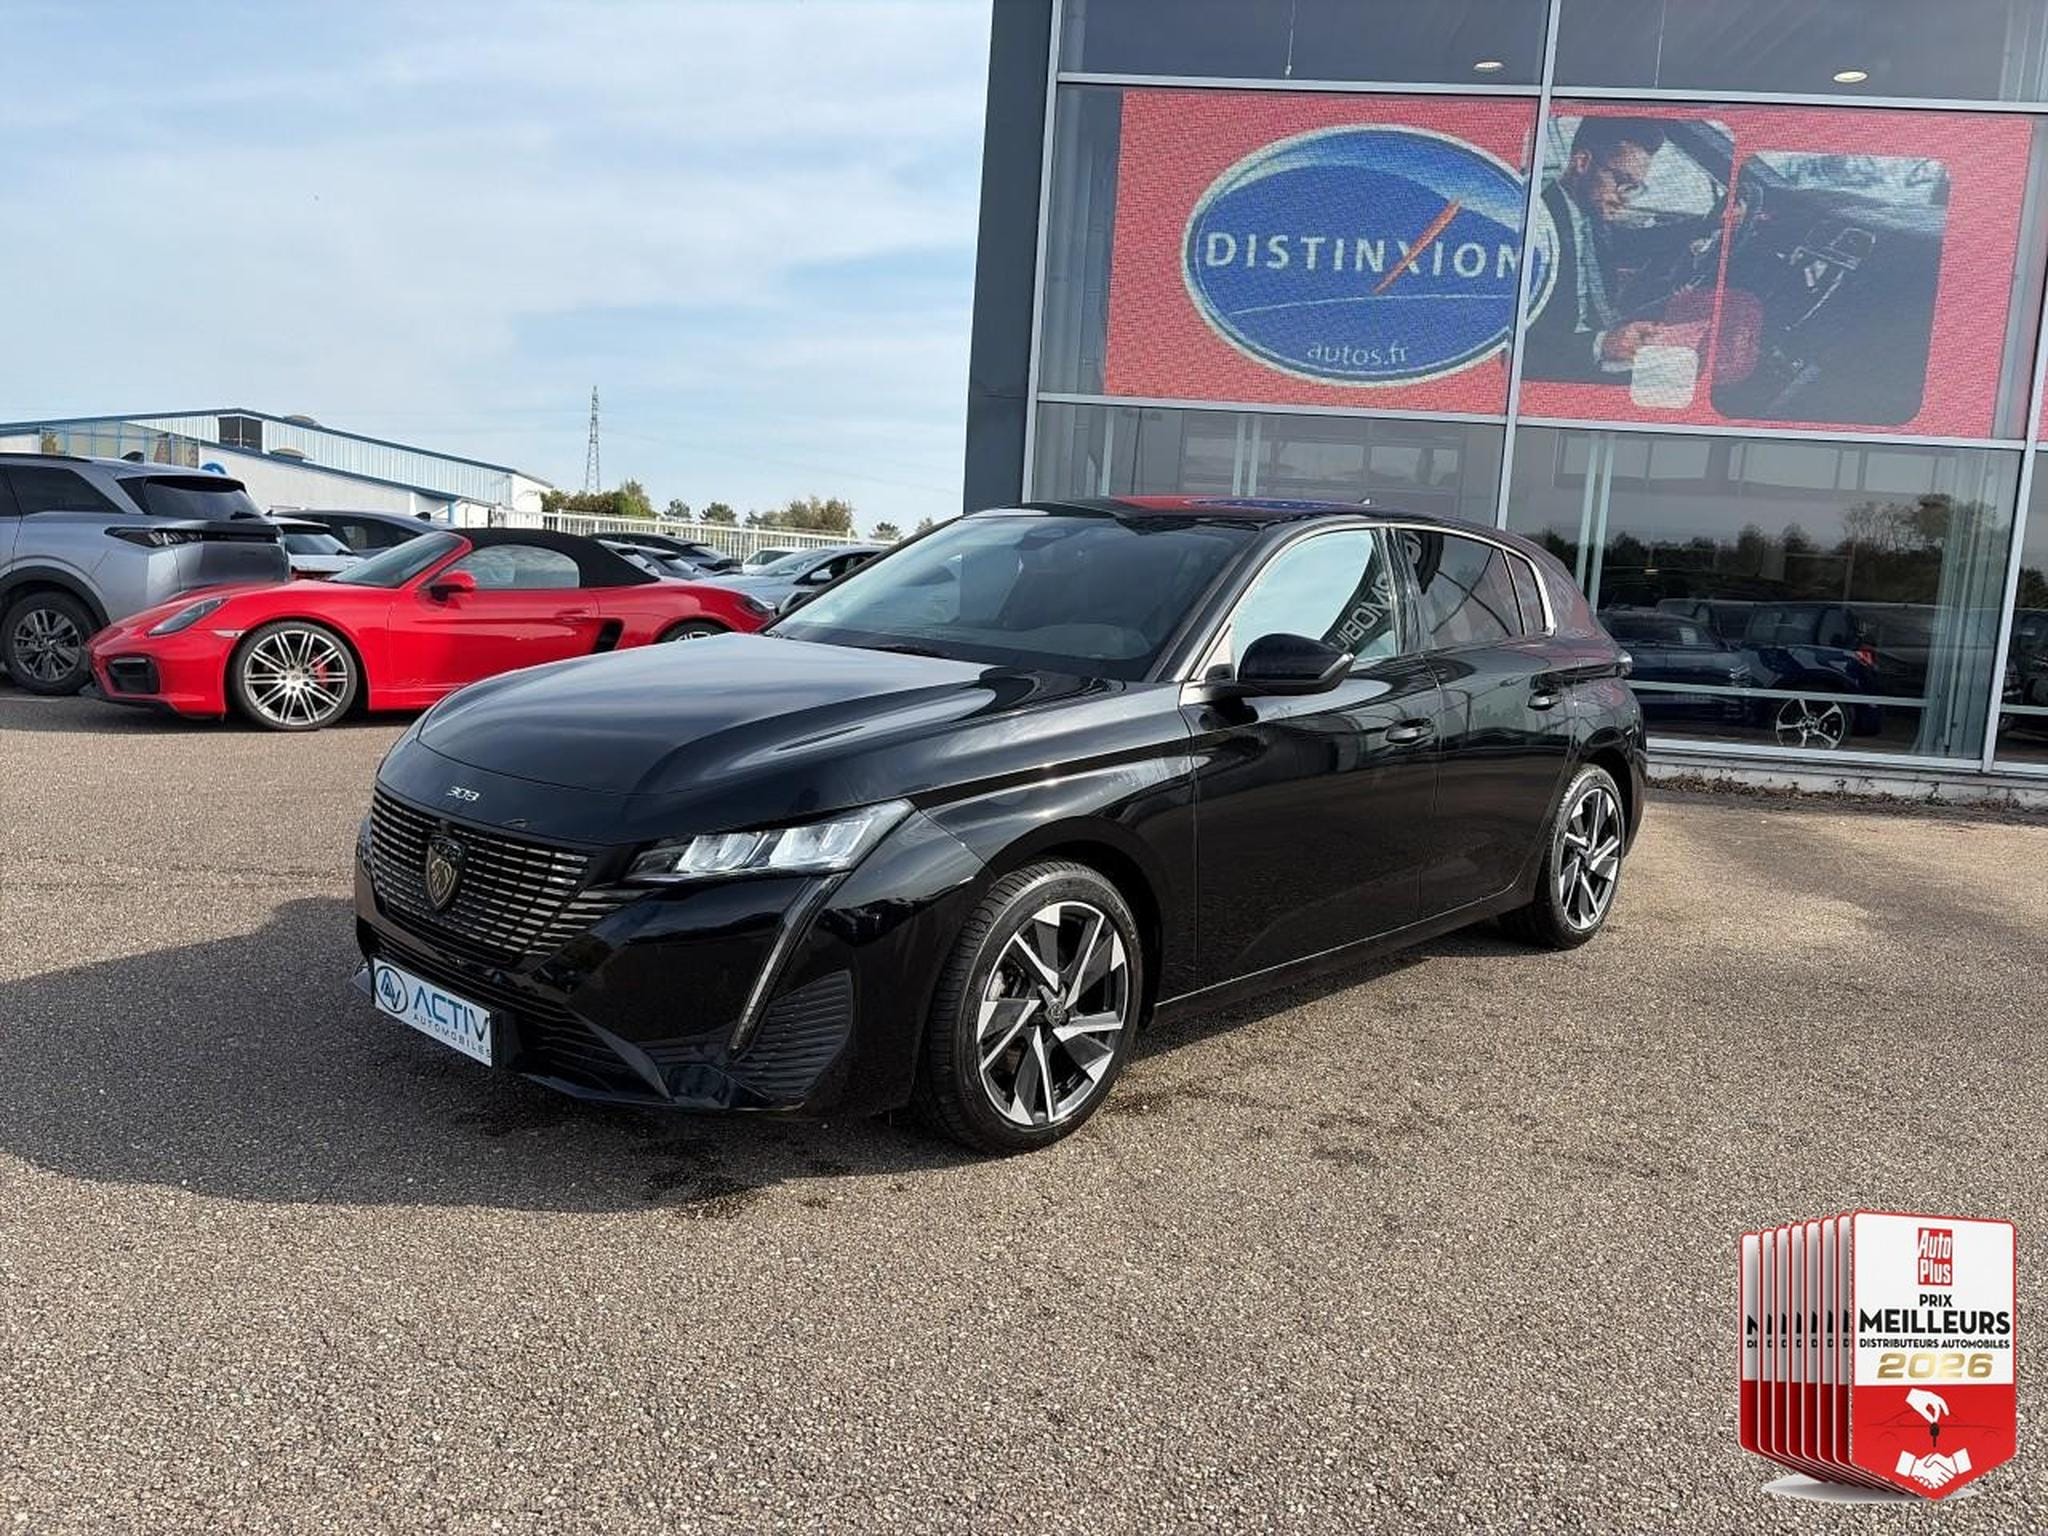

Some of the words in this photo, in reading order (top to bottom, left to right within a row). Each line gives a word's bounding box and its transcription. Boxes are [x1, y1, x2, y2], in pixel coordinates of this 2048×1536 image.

[1205, 230, 1518, 280] DISTINXION
[1307, 340, 1409, 366] autos.fr
[447, 785, 480, 801] 308
[414, 985, 489, 1042] ACTIV
